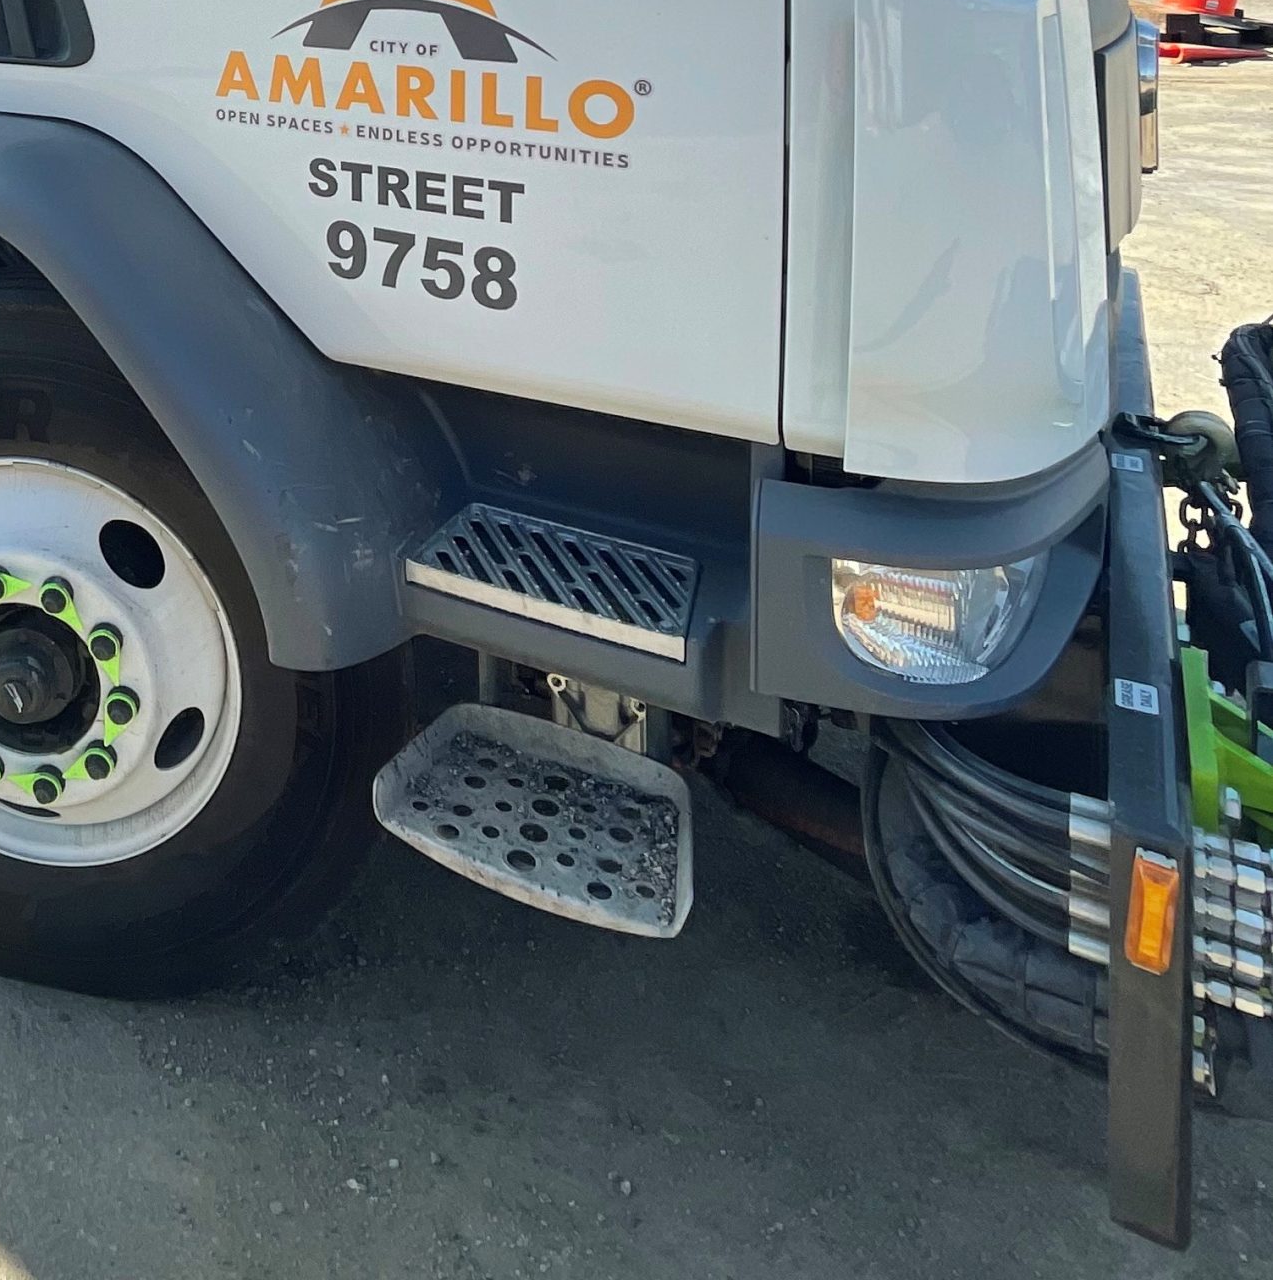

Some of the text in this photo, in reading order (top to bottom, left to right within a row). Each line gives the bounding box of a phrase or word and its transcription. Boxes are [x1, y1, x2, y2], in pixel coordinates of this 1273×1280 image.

[369, 40, 439, 57] CITY OF
[215, 108, 629, 168] OPEN SPACES ENDLESS OPPORTUNITIES
[308, 157, 525, 224] STREET
[327, 220, 518, 311] 9758
